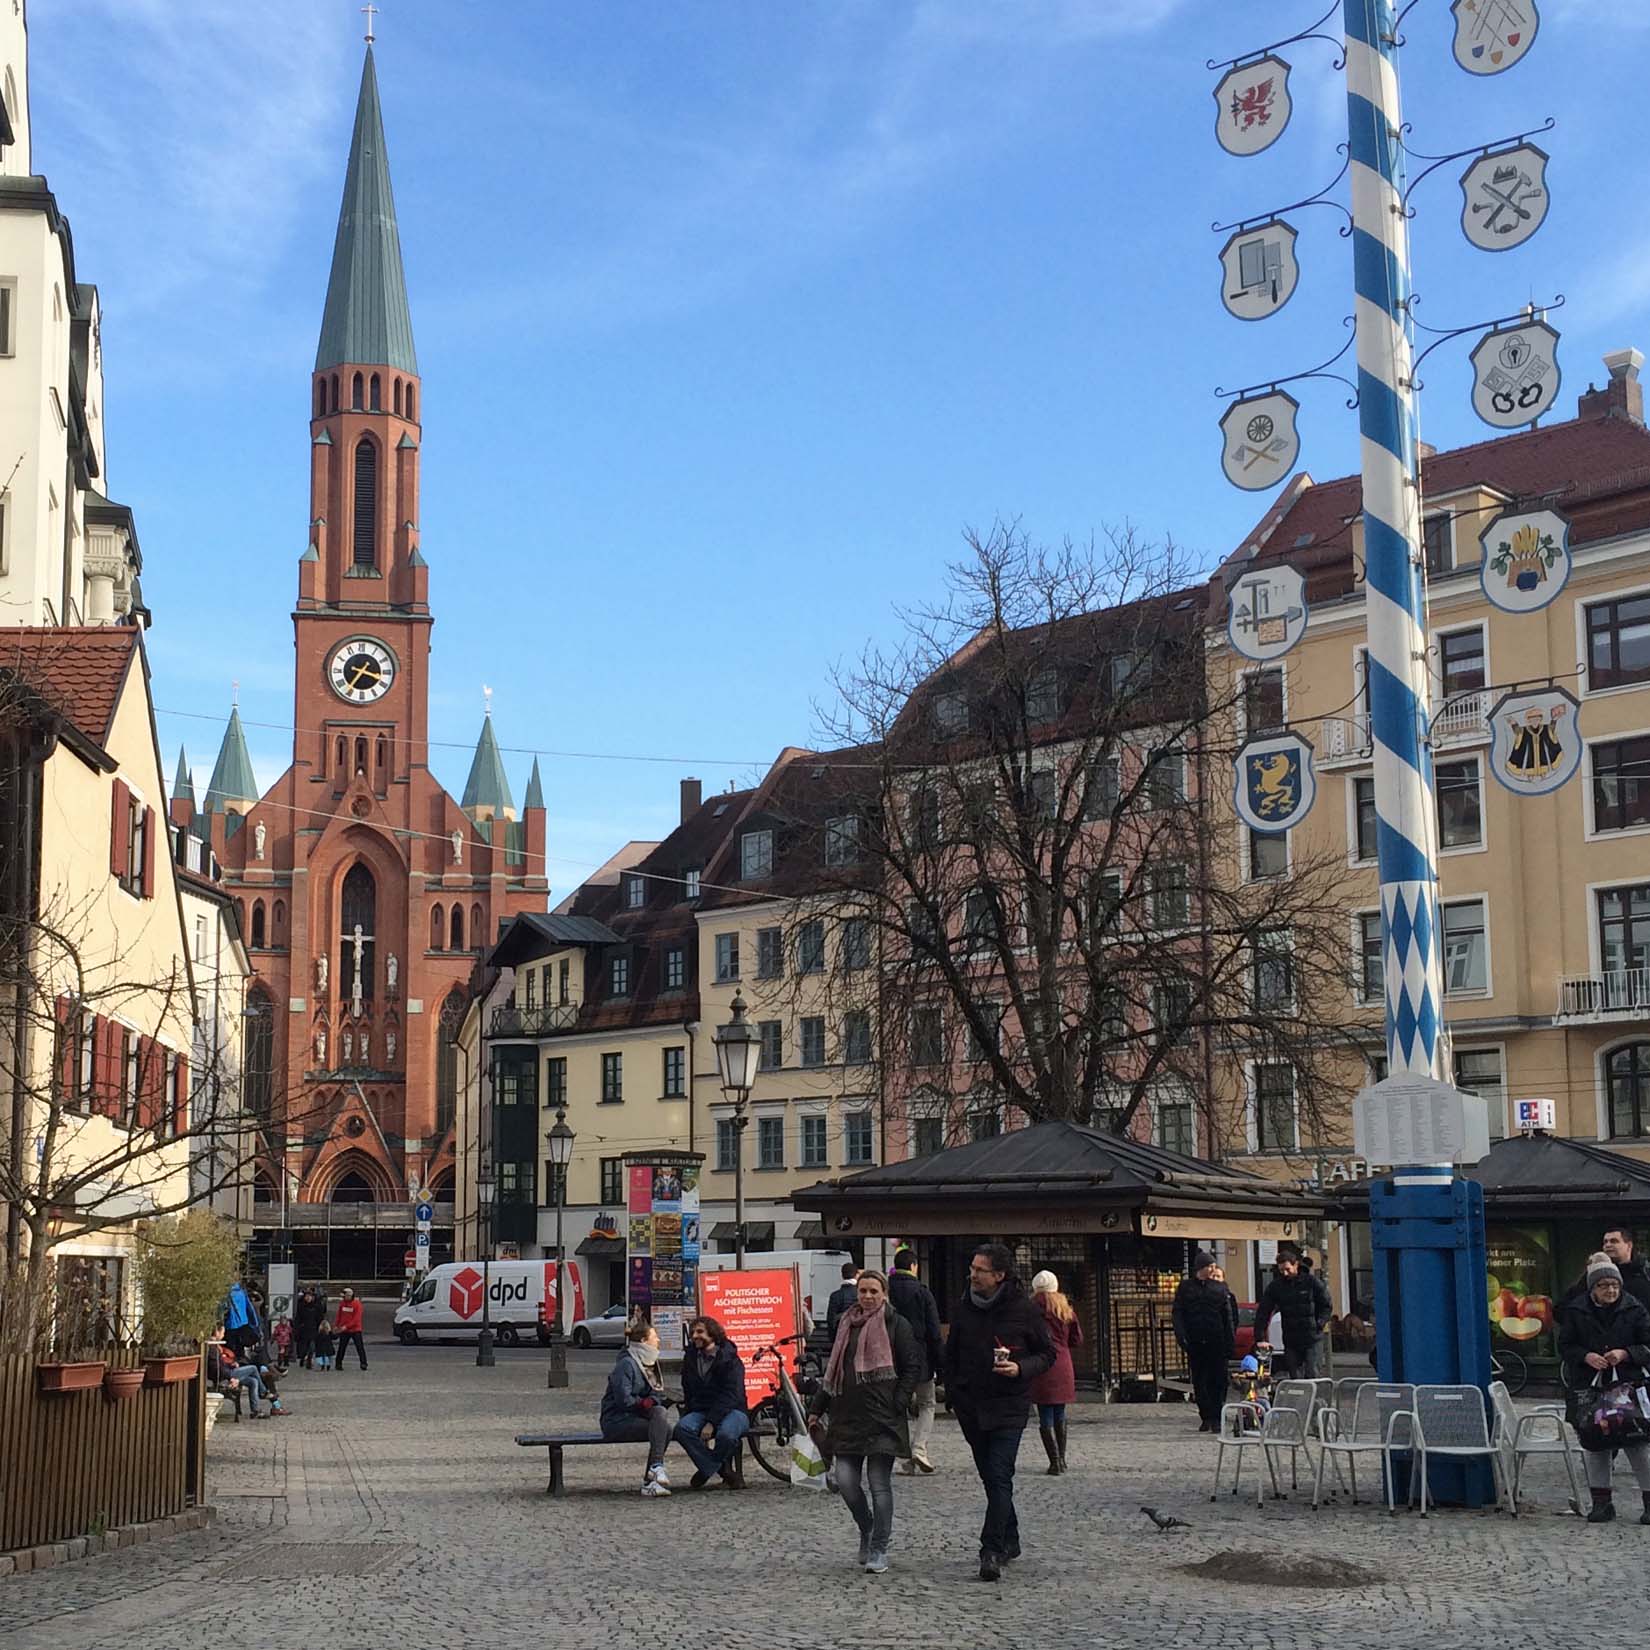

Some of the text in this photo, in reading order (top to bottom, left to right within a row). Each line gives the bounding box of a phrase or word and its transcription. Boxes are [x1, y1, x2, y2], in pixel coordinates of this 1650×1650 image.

[502, 1246, 517, 1256] dm
[490, 1277, 527, 1306] dpd
[725, 1288, 770, 1297] POLITISCHER
[713, 1296, 783, 1307] ASCHERMITTWOCH
[723, 1307, 736, 1315] mit
